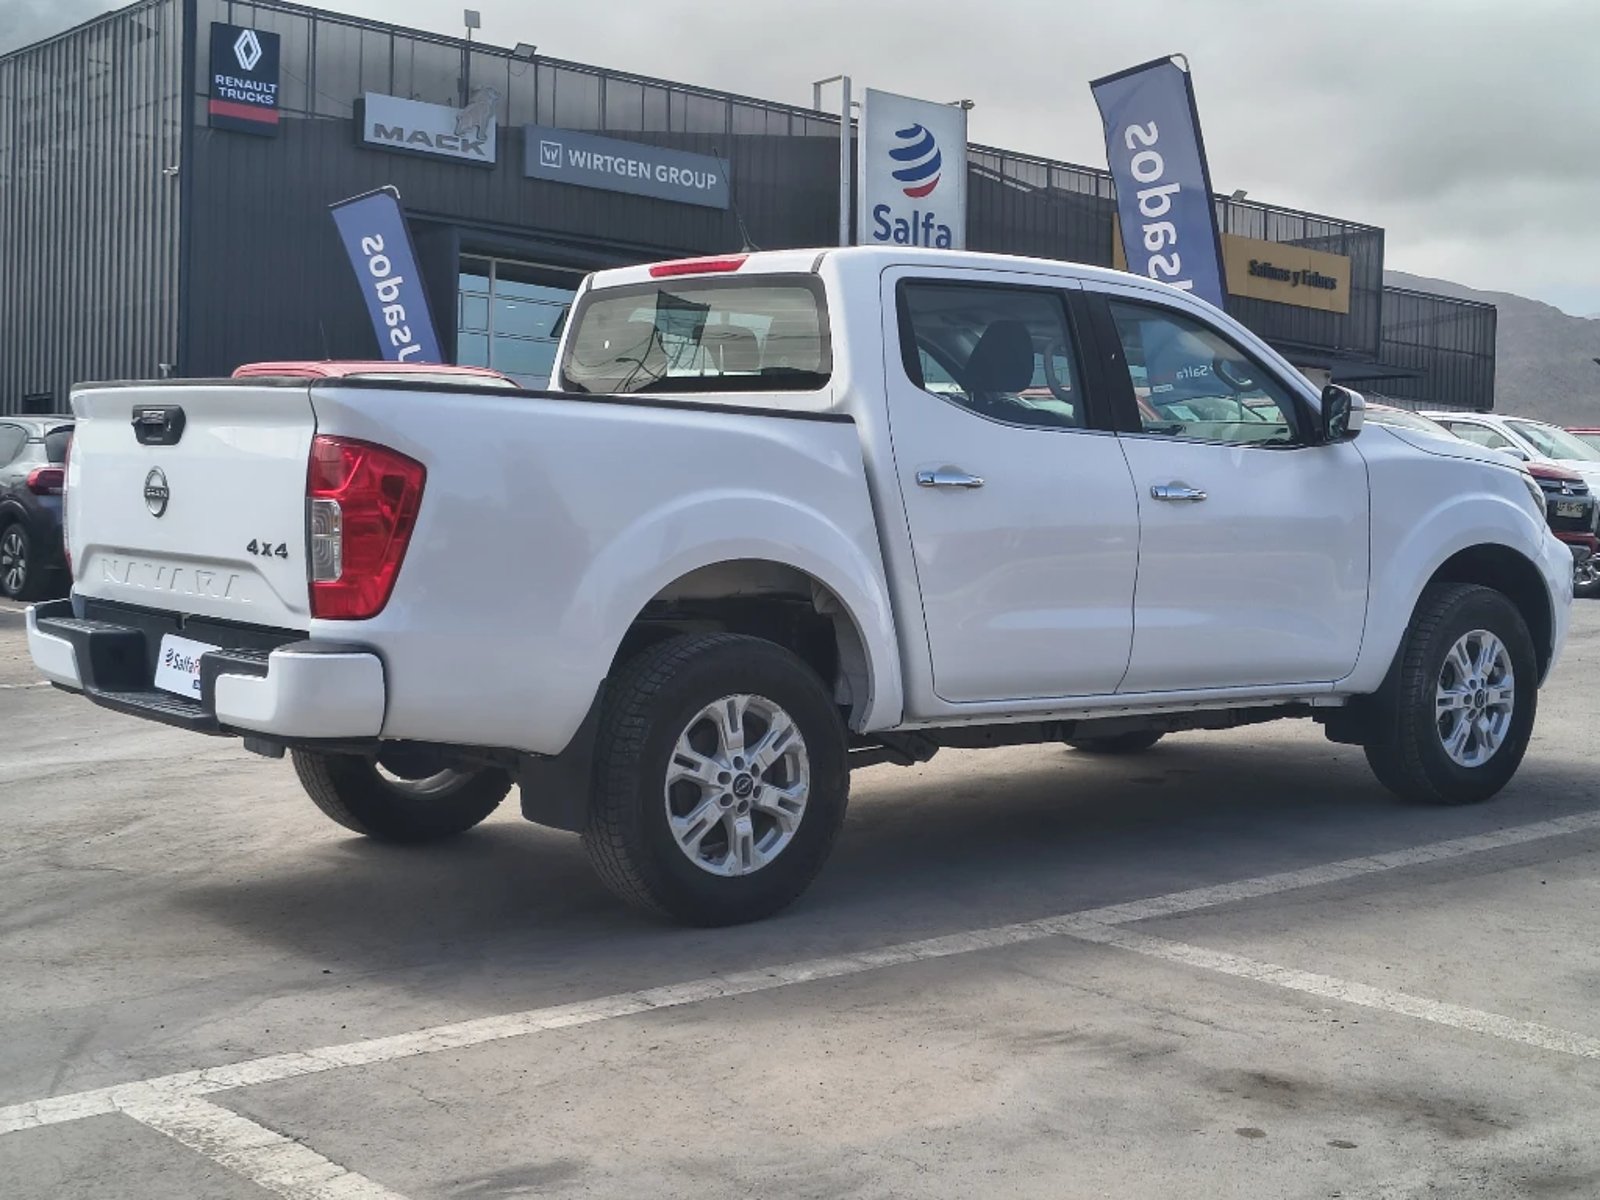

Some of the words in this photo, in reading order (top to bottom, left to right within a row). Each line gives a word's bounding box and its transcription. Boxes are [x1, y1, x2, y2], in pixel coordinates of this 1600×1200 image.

[214, 74, 278, 94] RENAULT
[218, 87, 274, 105] TRUCKS
[374, 122, 486, 156] MACK
[568, 149, 651, 180] WIRTGEN
[655, 165, 717, 190] GROUP
[872, 203, 953, 249] Salfa
[247, 538, 288, 559] 4x4
